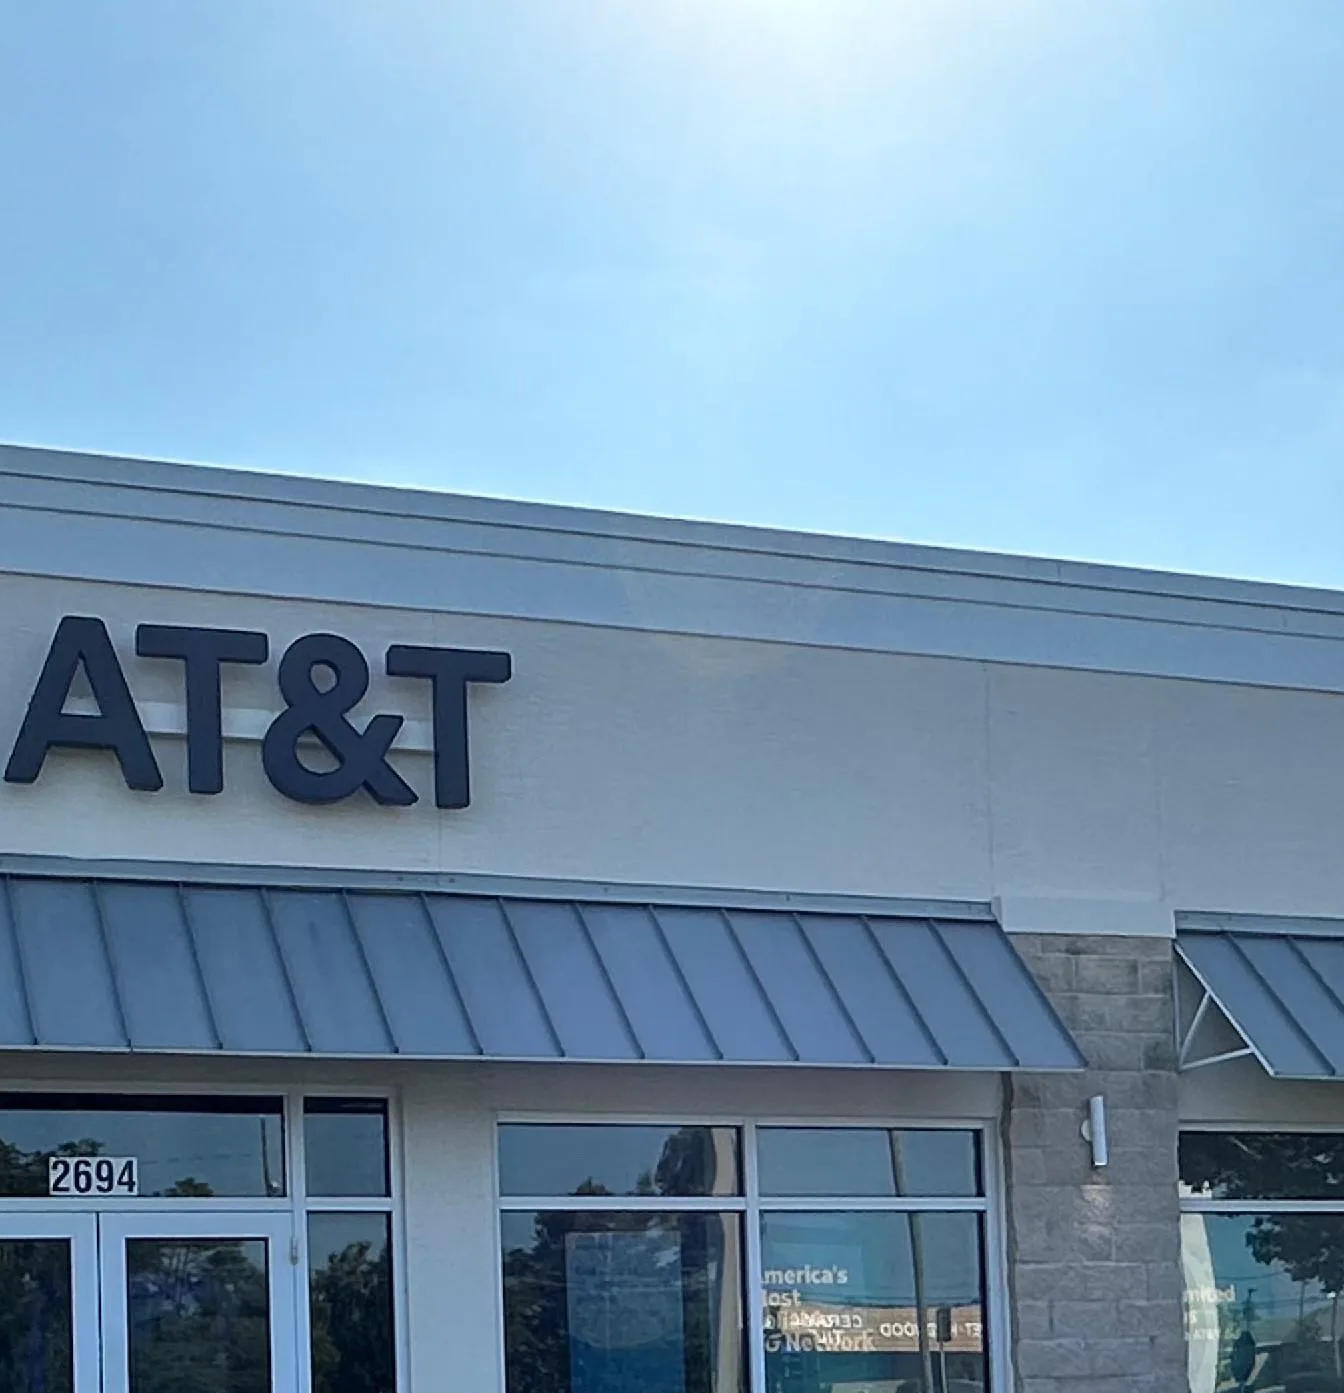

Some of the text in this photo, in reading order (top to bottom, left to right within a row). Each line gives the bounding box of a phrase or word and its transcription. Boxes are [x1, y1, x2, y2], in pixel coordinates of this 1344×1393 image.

[3, 614, 513, 810] AT&T
[51, 1159, 136, 1194] 2694
[761, 1264, 848, 1285] merica's
